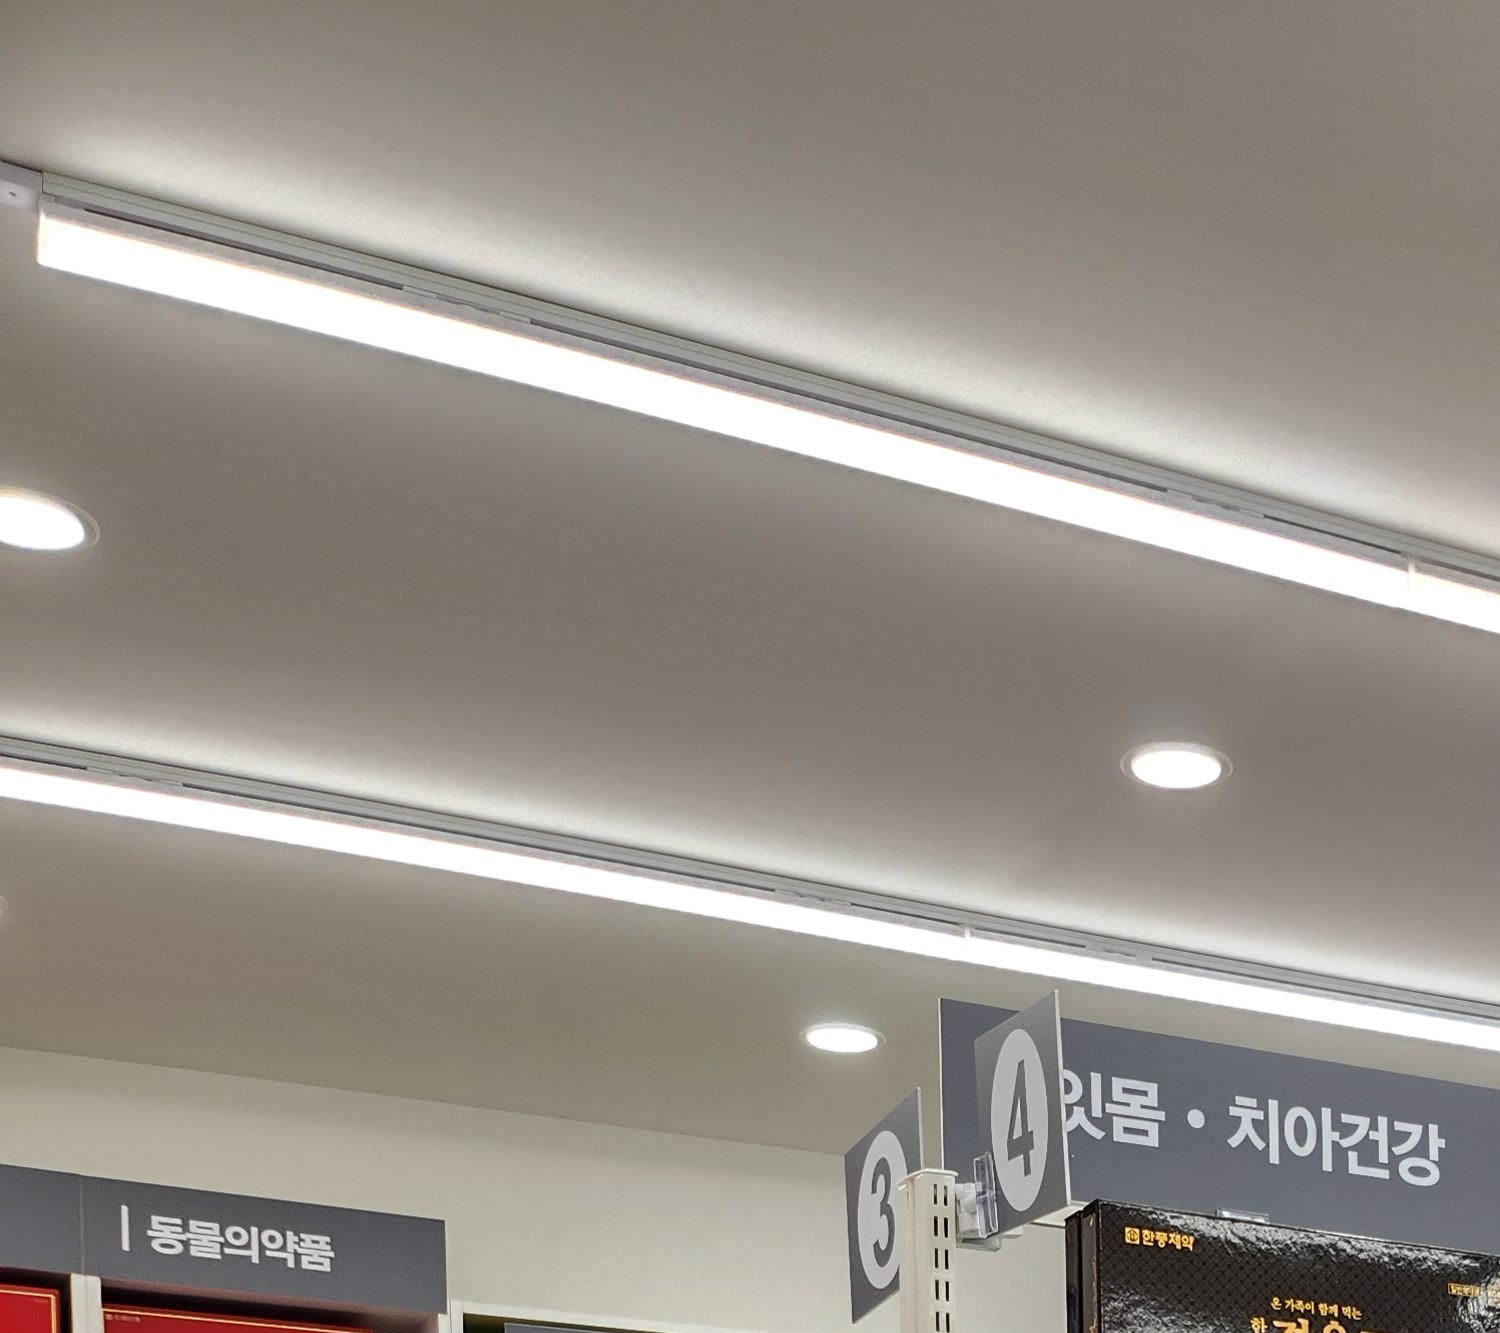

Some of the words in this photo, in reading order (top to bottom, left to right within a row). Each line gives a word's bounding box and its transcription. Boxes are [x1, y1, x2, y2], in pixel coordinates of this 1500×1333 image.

[1005, 1056, 1037, 1180] 4
[1062, 1068, 1166, 1148] 잇몸
[1227, 1092, 1445, 1187] 치아건강
[147, 1214, 336, 1273] 동물의약품
[867, 1149, 899, 1270] 3
